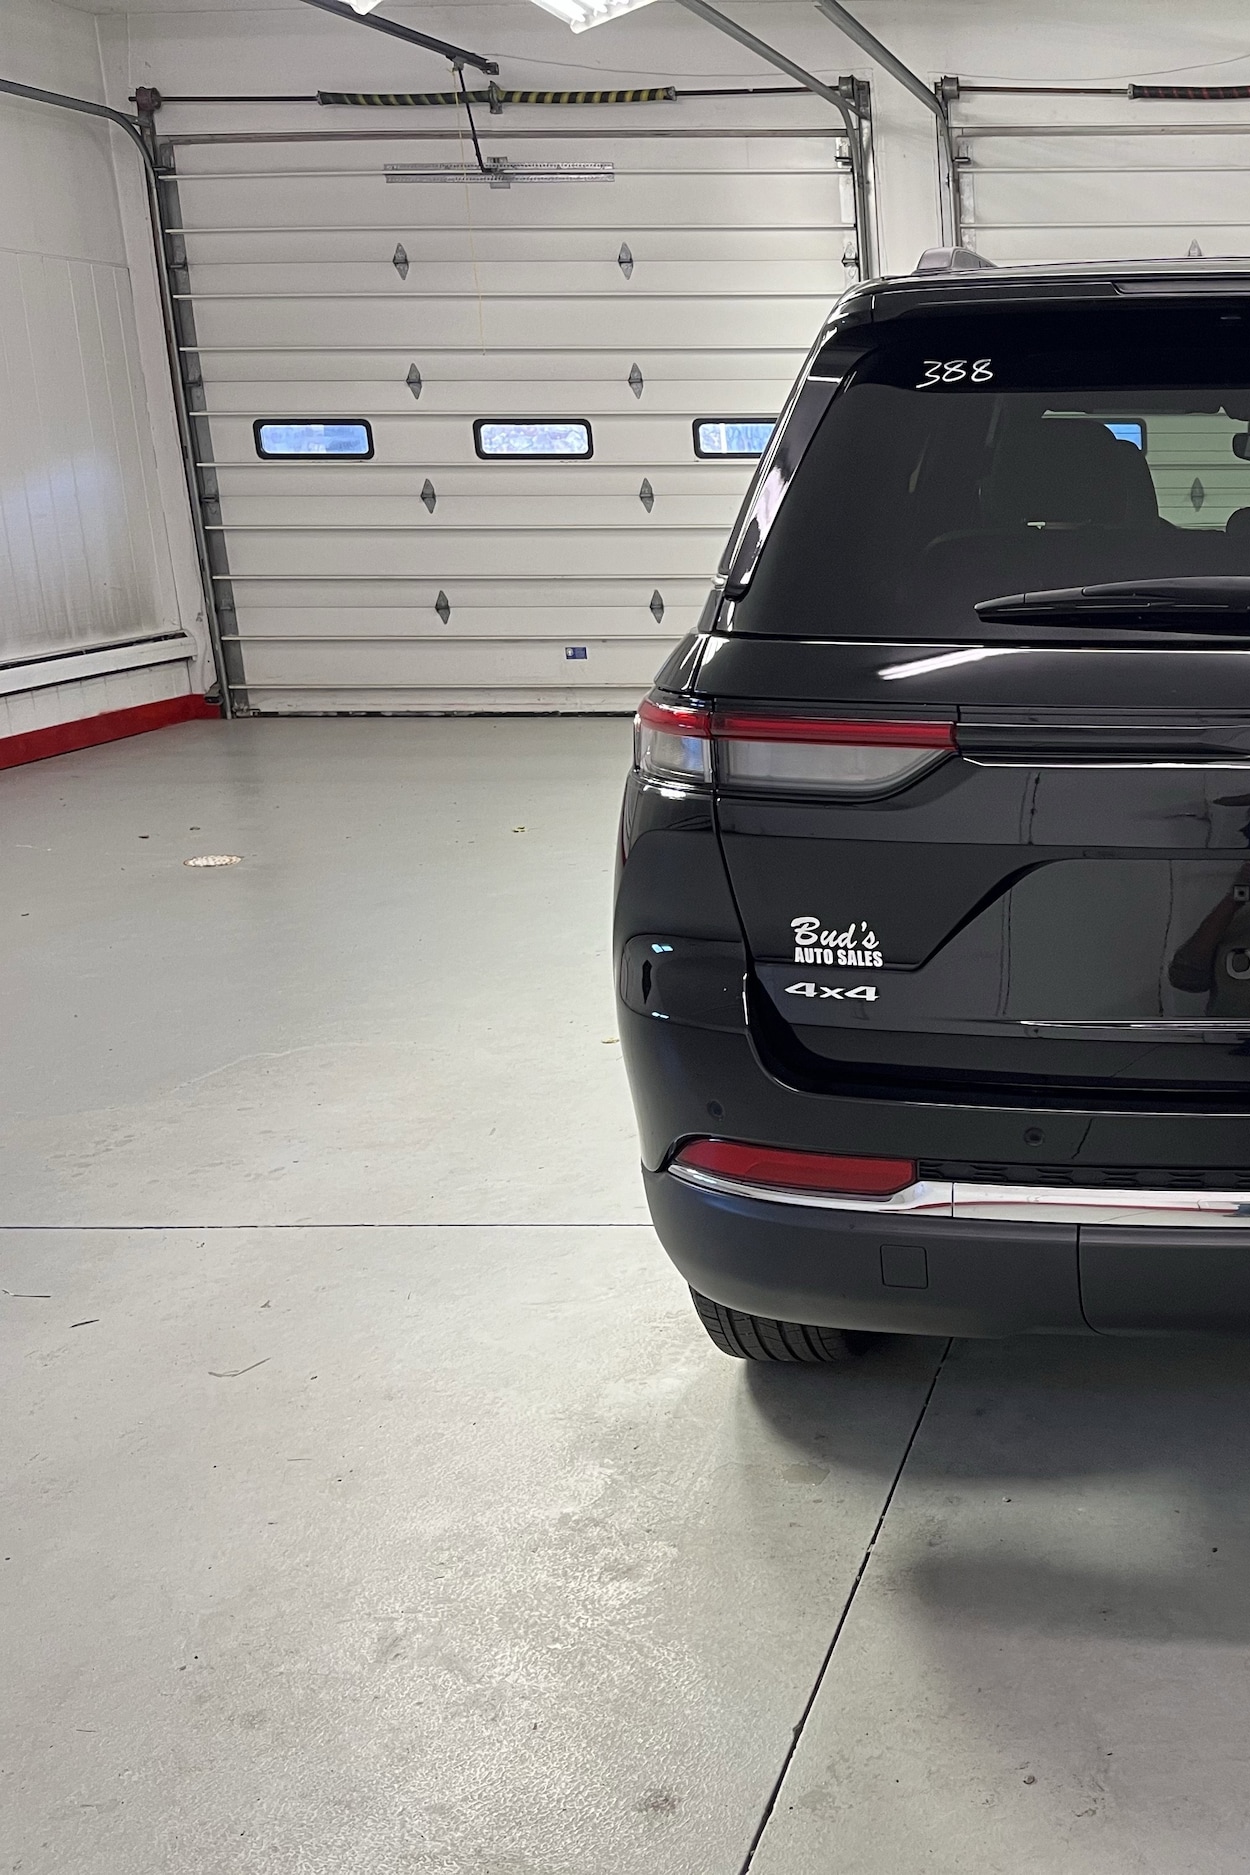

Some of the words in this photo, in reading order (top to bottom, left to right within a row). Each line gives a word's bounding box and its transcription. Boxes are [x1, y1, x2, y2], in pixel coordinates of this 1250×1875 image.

[915, 358, 994, 389] 388
[790, 916, 880, 950] Bud's
[794, 946, 834, 965] AUTO
[836, 948, 884, 967] SALES
[784, 982, 880, 1002] 4x4
